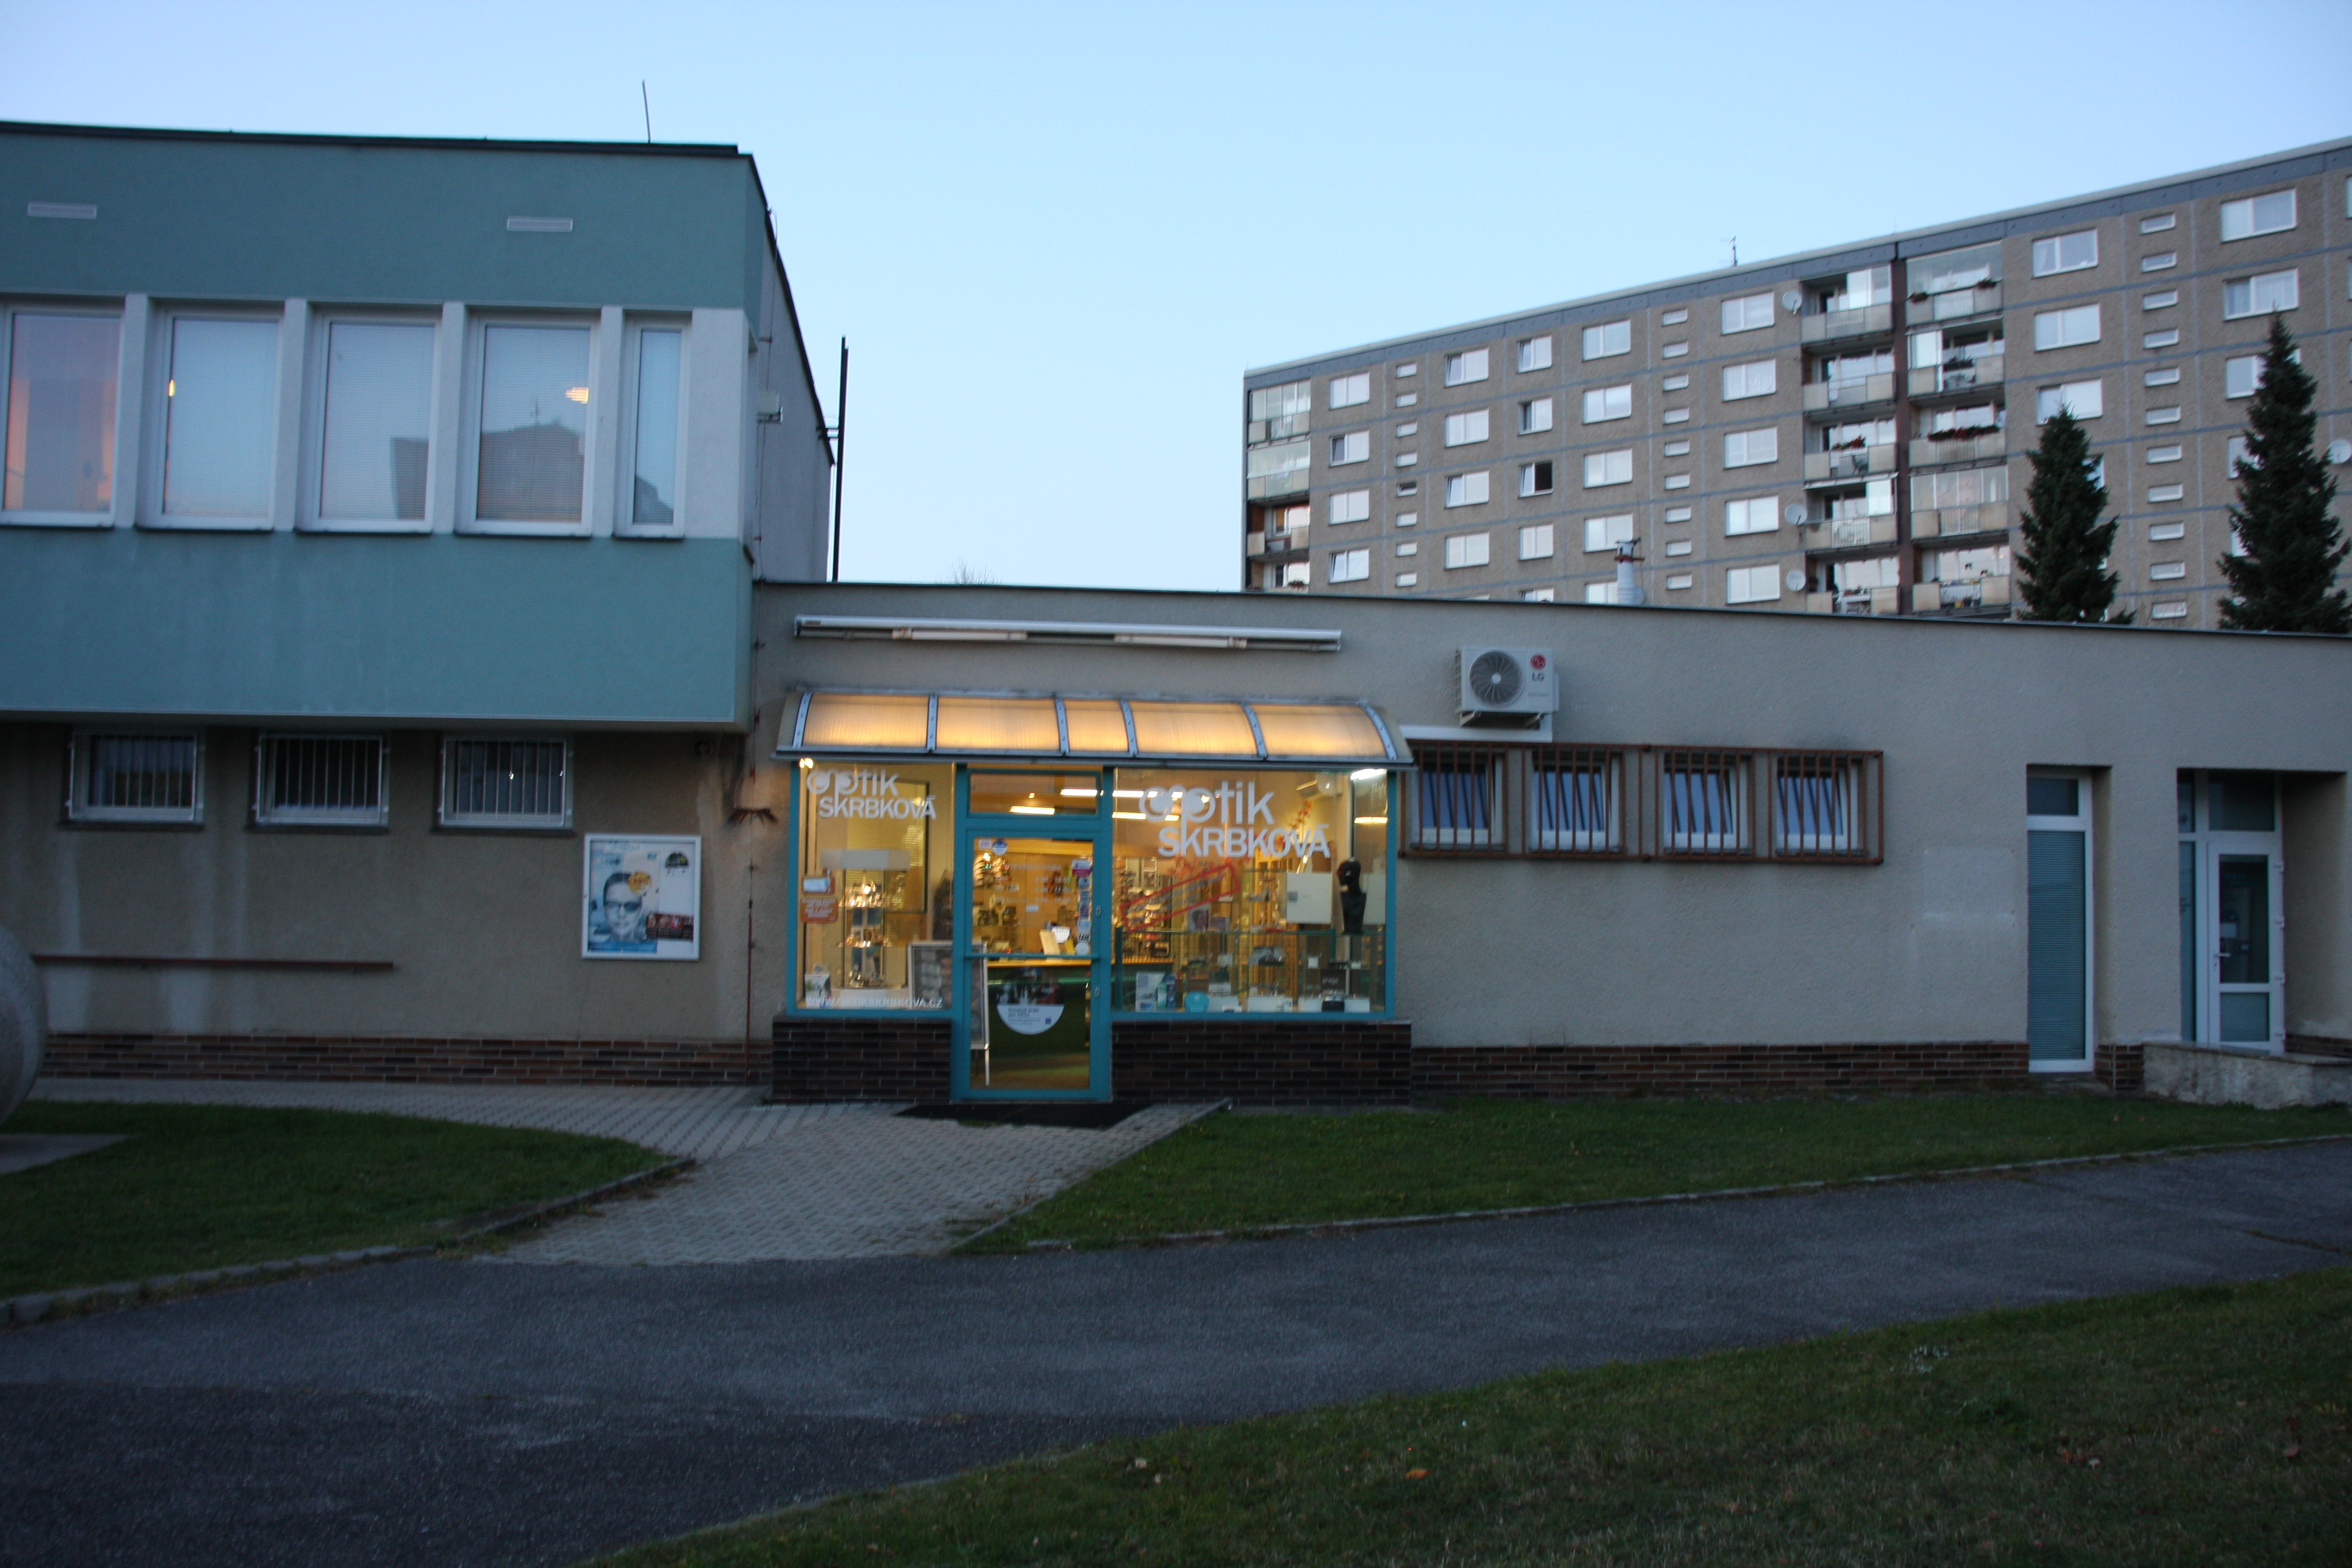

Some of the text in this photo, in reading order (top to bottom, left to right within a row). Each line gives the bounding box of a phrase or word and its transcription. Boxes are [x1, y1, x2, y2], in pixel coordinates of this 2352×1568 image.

[1532, 673, 1544, 681] LG
[806, 767, 900, 797] optik
[818, 794, 937, 820] SKRBKOVÁ
[1138, 780, 1275, 825] optik
[1158, 823, 1331, 858] SKRBKOVÁ
